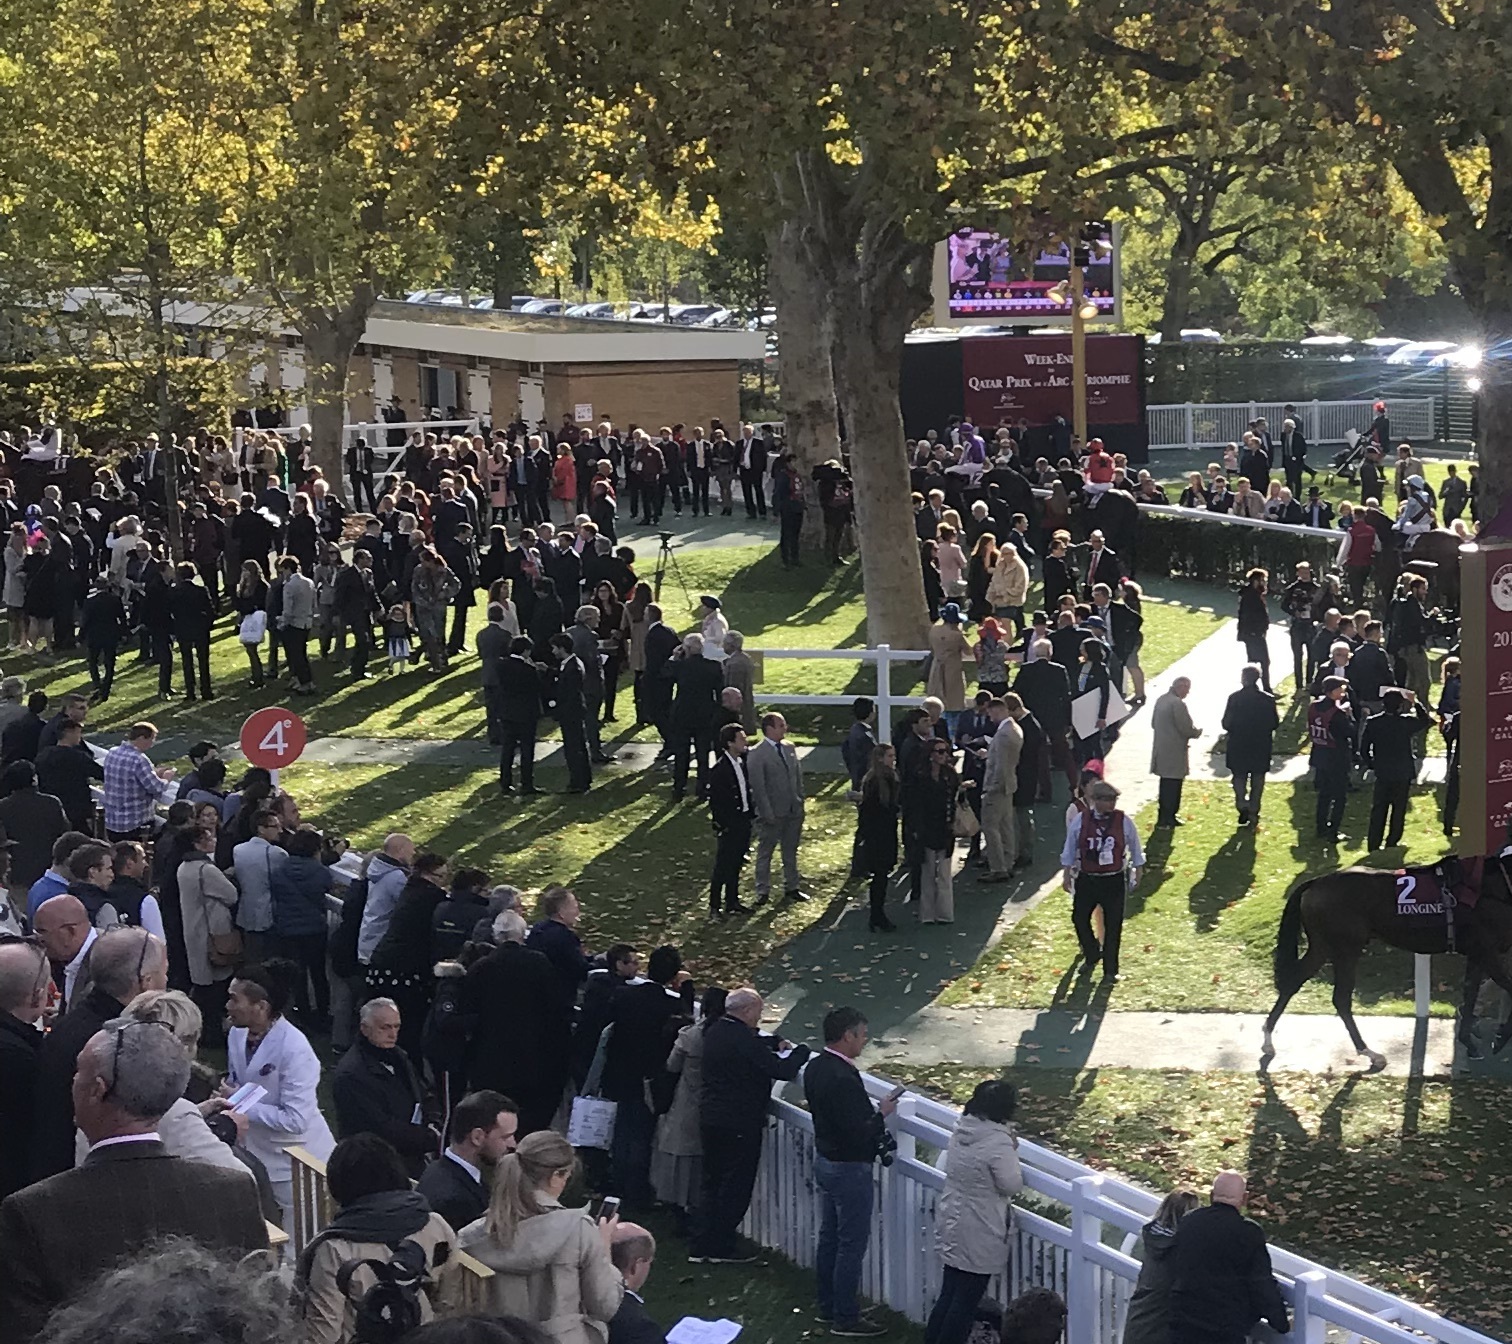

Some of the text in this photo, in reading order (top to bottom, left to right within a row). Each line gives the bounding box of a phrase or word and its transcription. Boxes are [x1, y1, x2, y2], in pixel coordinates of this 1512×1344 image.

[1084, 373, 1131, 385] RIOMPHE
[1396, 875, 1416, 904] 2
[1397, 903, 1446, 915] LONGINE
